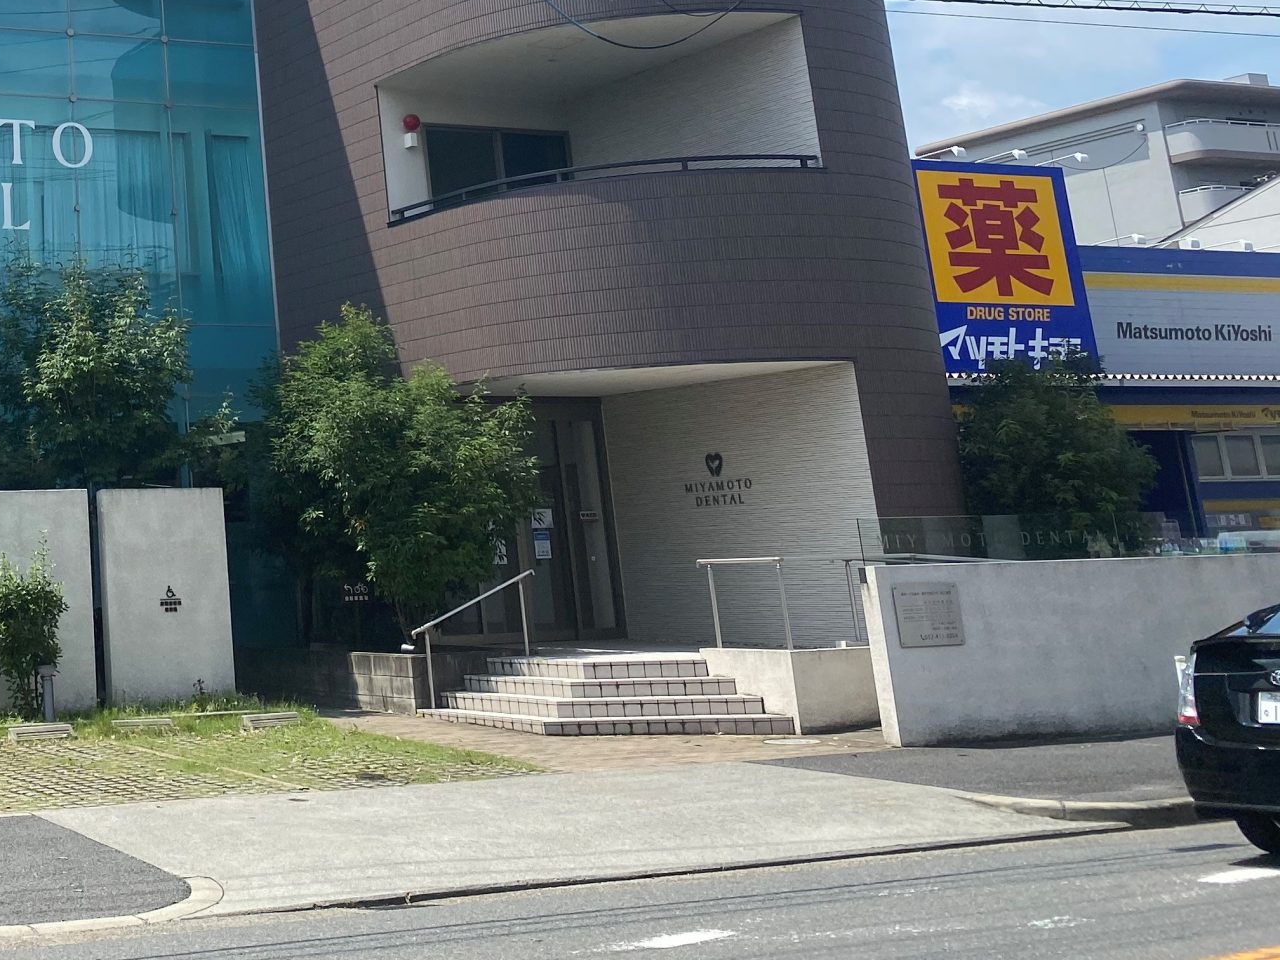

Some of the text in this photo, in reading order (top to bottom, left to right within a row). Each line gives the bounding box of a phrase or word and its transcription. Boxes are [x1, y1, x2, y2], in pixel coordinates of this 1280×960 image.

[937, 178, 1055, 297] 薬
[966, 306, 1051, 322] DRUG STORE
[1116, 321, 1272, 342] Matsumoto KiYoshi
[685, 478, 752, 493] MIYAMOTO
[695, 493, 745, 507] DENTAL
